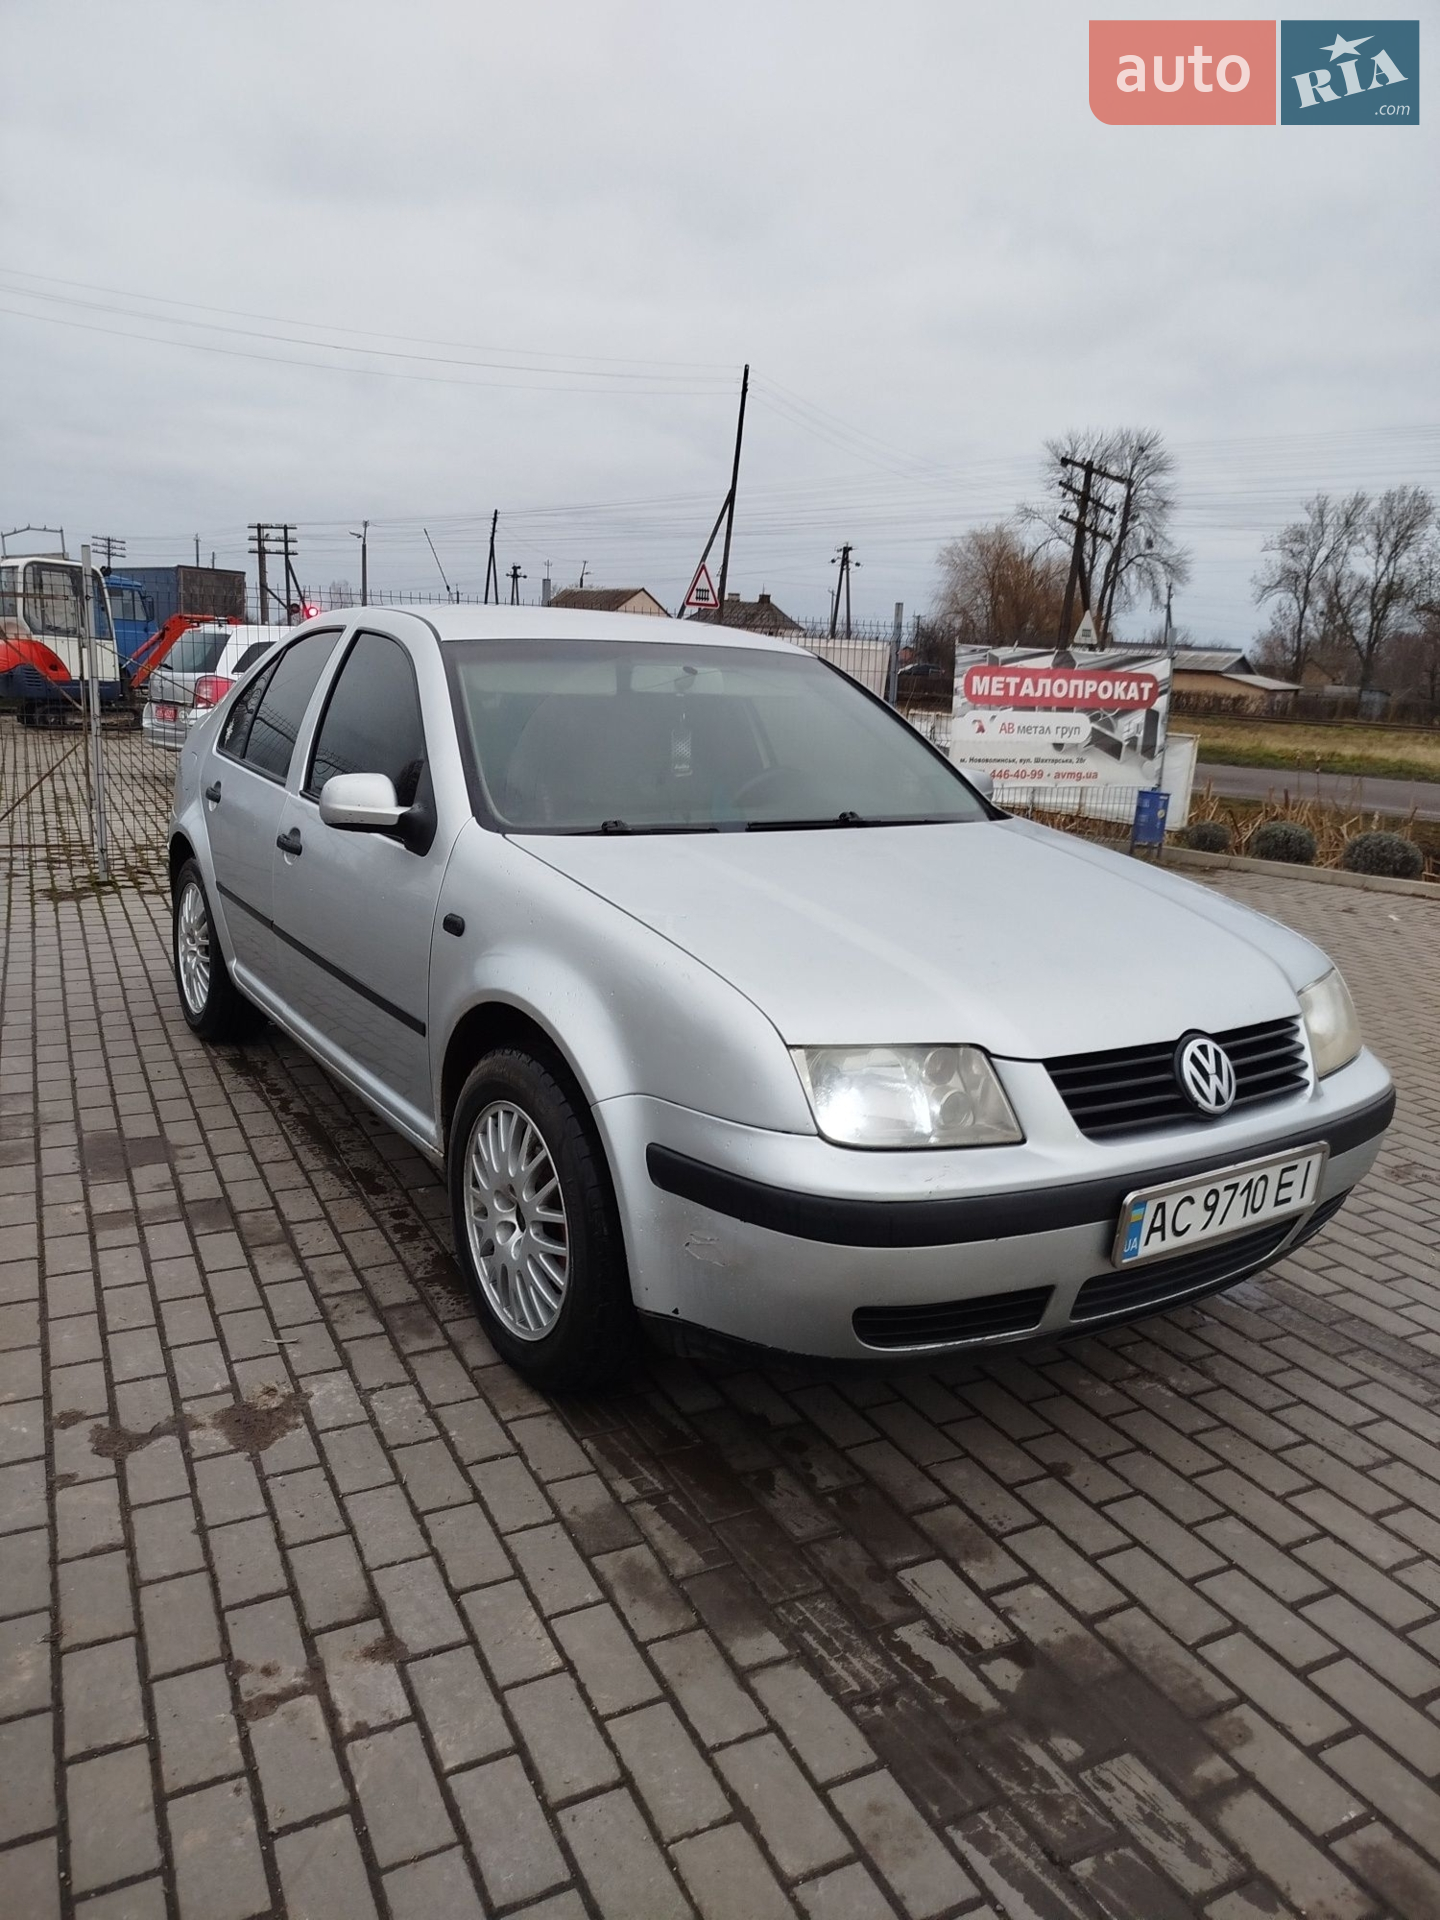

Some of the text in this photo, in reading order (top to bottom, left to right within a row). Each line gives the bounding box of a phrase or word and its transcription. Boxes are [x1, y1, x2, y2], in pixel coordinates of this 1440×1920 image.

[971, 675, 1153, 701] МЕТАЛОПРОКАТ
[1016, 725, 1051, 735] метал
[1055, 726, 1081, 738] груп
[1054, 771, 1099, 782] avmg.ua
[1144, 1160, 1312, 1246] AC 9710 EI
[1124, 1237, 1138, 1253] UA
